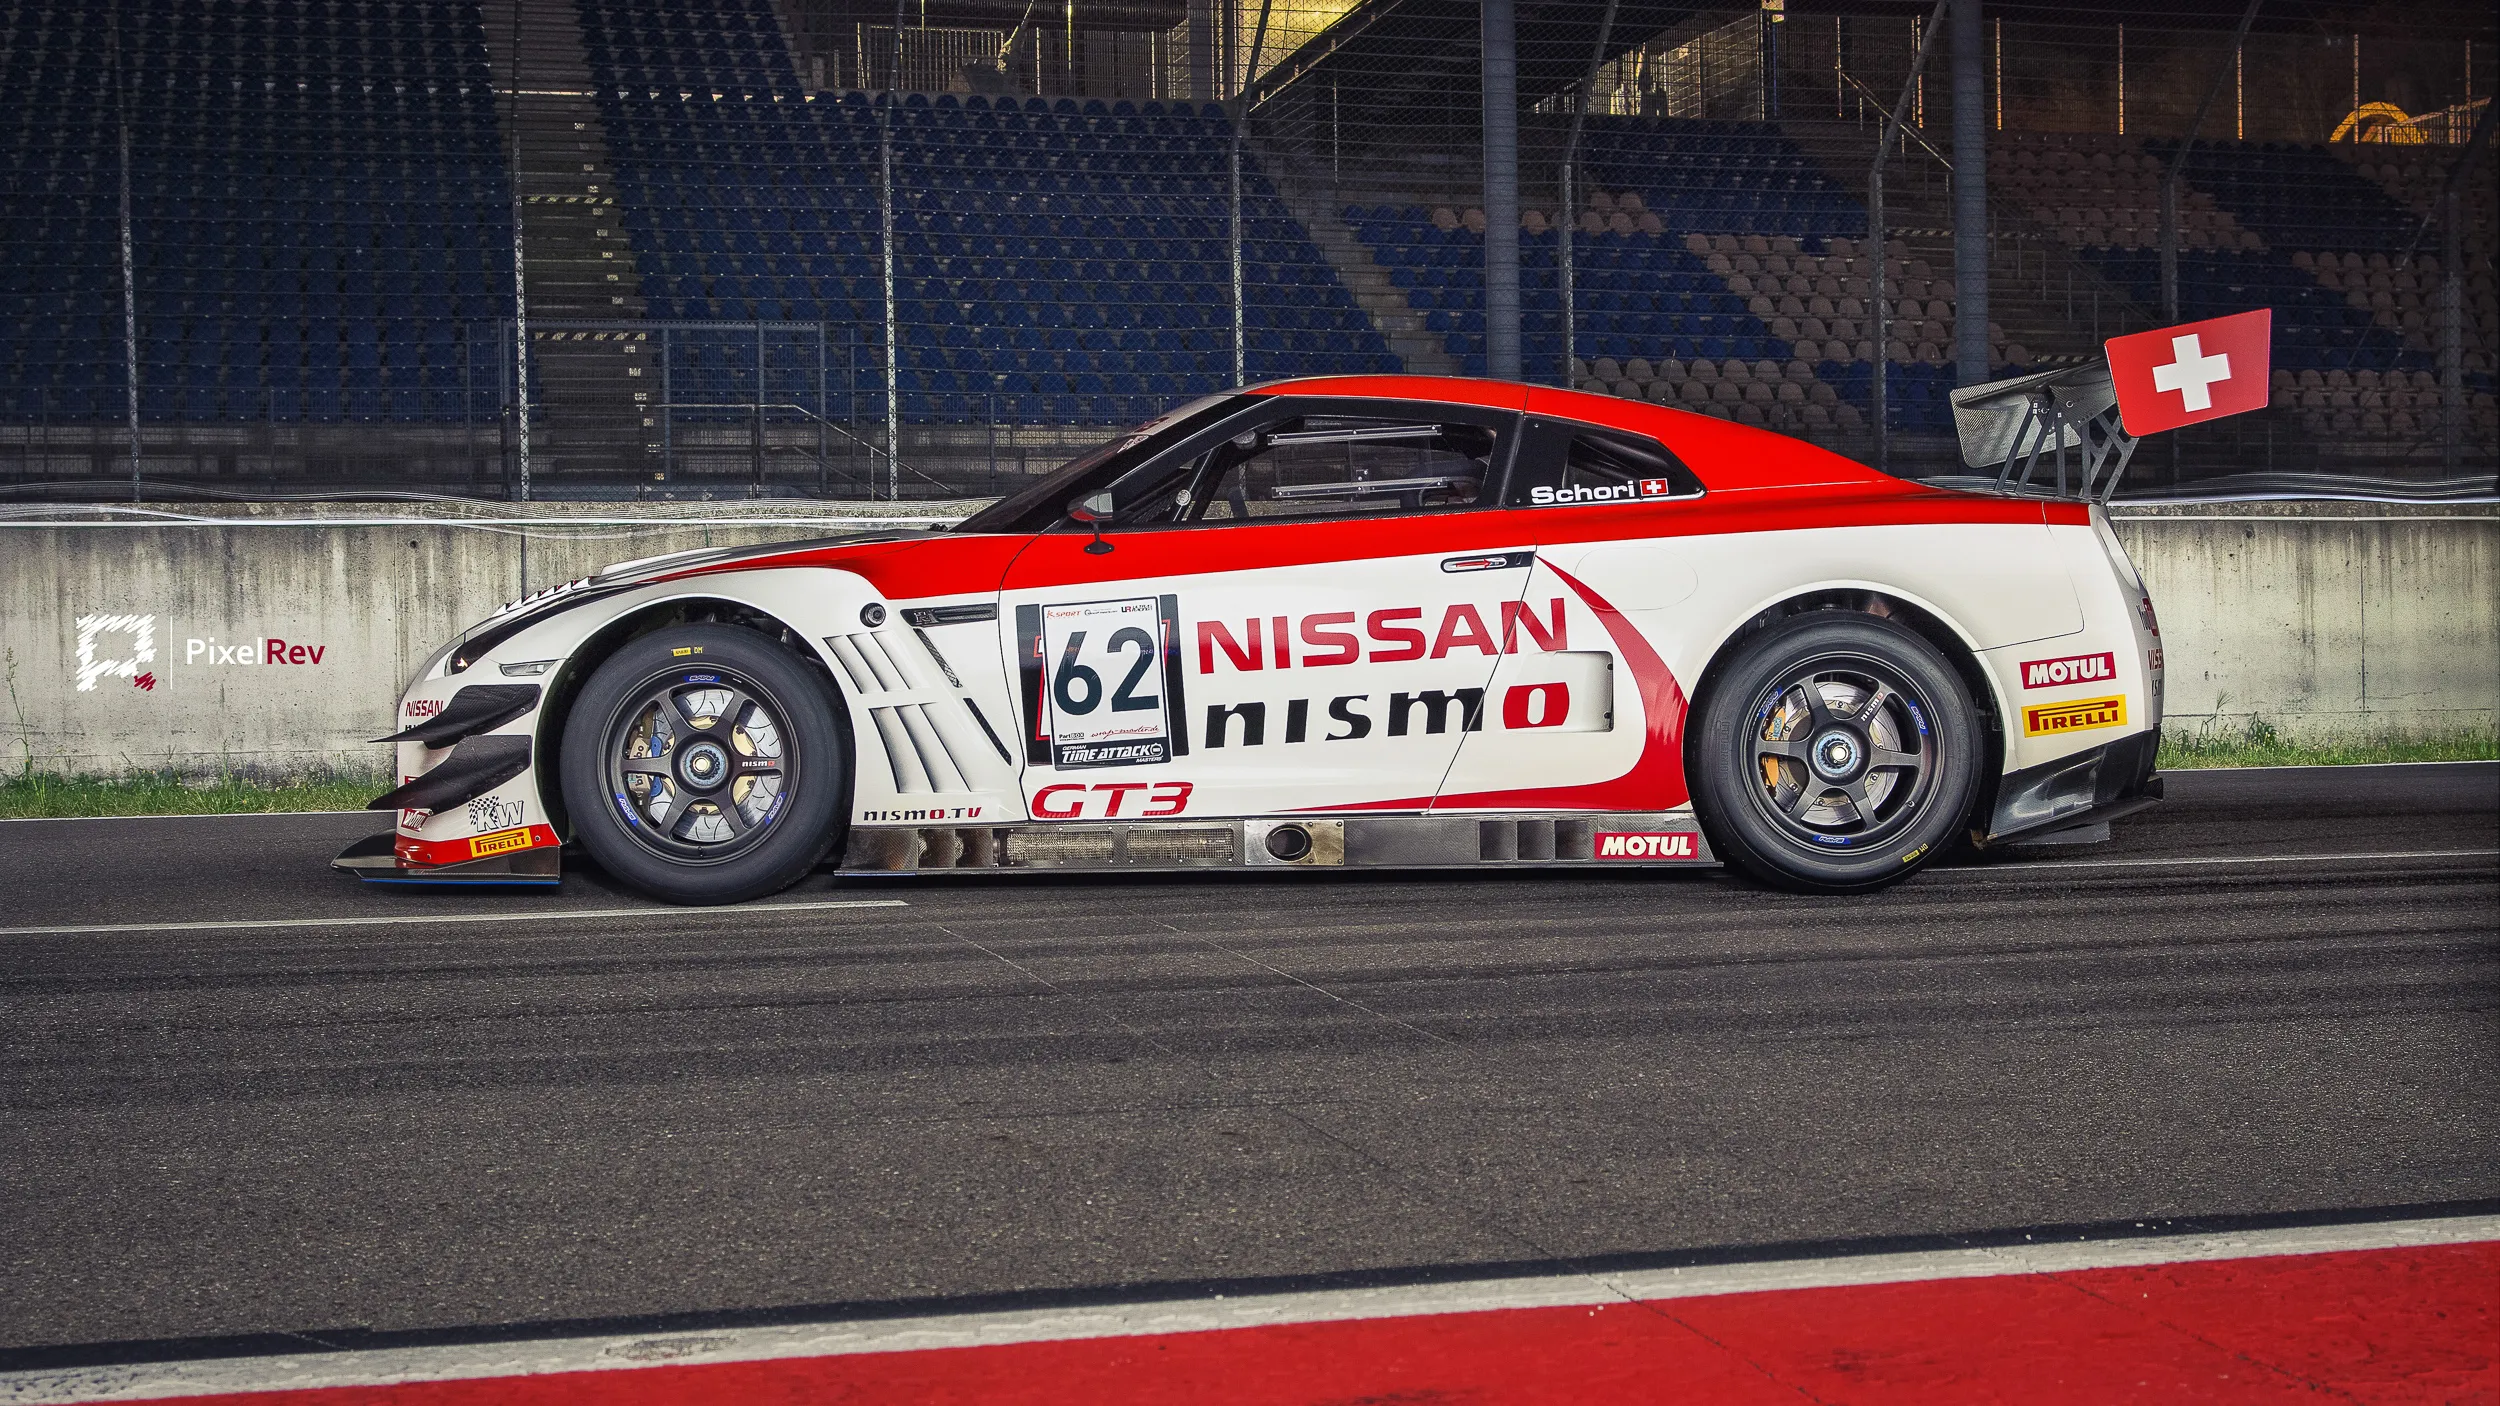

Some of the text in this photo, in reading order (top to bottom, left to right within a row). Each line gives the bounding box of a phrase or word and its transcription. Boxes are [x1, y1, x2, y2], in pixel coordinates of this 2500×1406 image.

[1531, 481, 1635, 504] Schori
[1197, 598, 1567, 675] NISSAN
[1054, 627, 1159, 716] 62
[2028, 656, 2110, 685] MOTUL
[405, 699, 444, 717] NISSAN
[1205, 682, 1570, 749] nismo
[2028, 700, 2119, 732] PIRELLI
[741, 760, 776, 768] nismo
[1097, 744, 1151, 760] ATTACK
[1031, 781, 1194, 818] GT3
[476, 800, 525, 832] KW
[475, 831, 526, 853] PIRELLI
[1601, 836, 1692, 856] MOTUL
